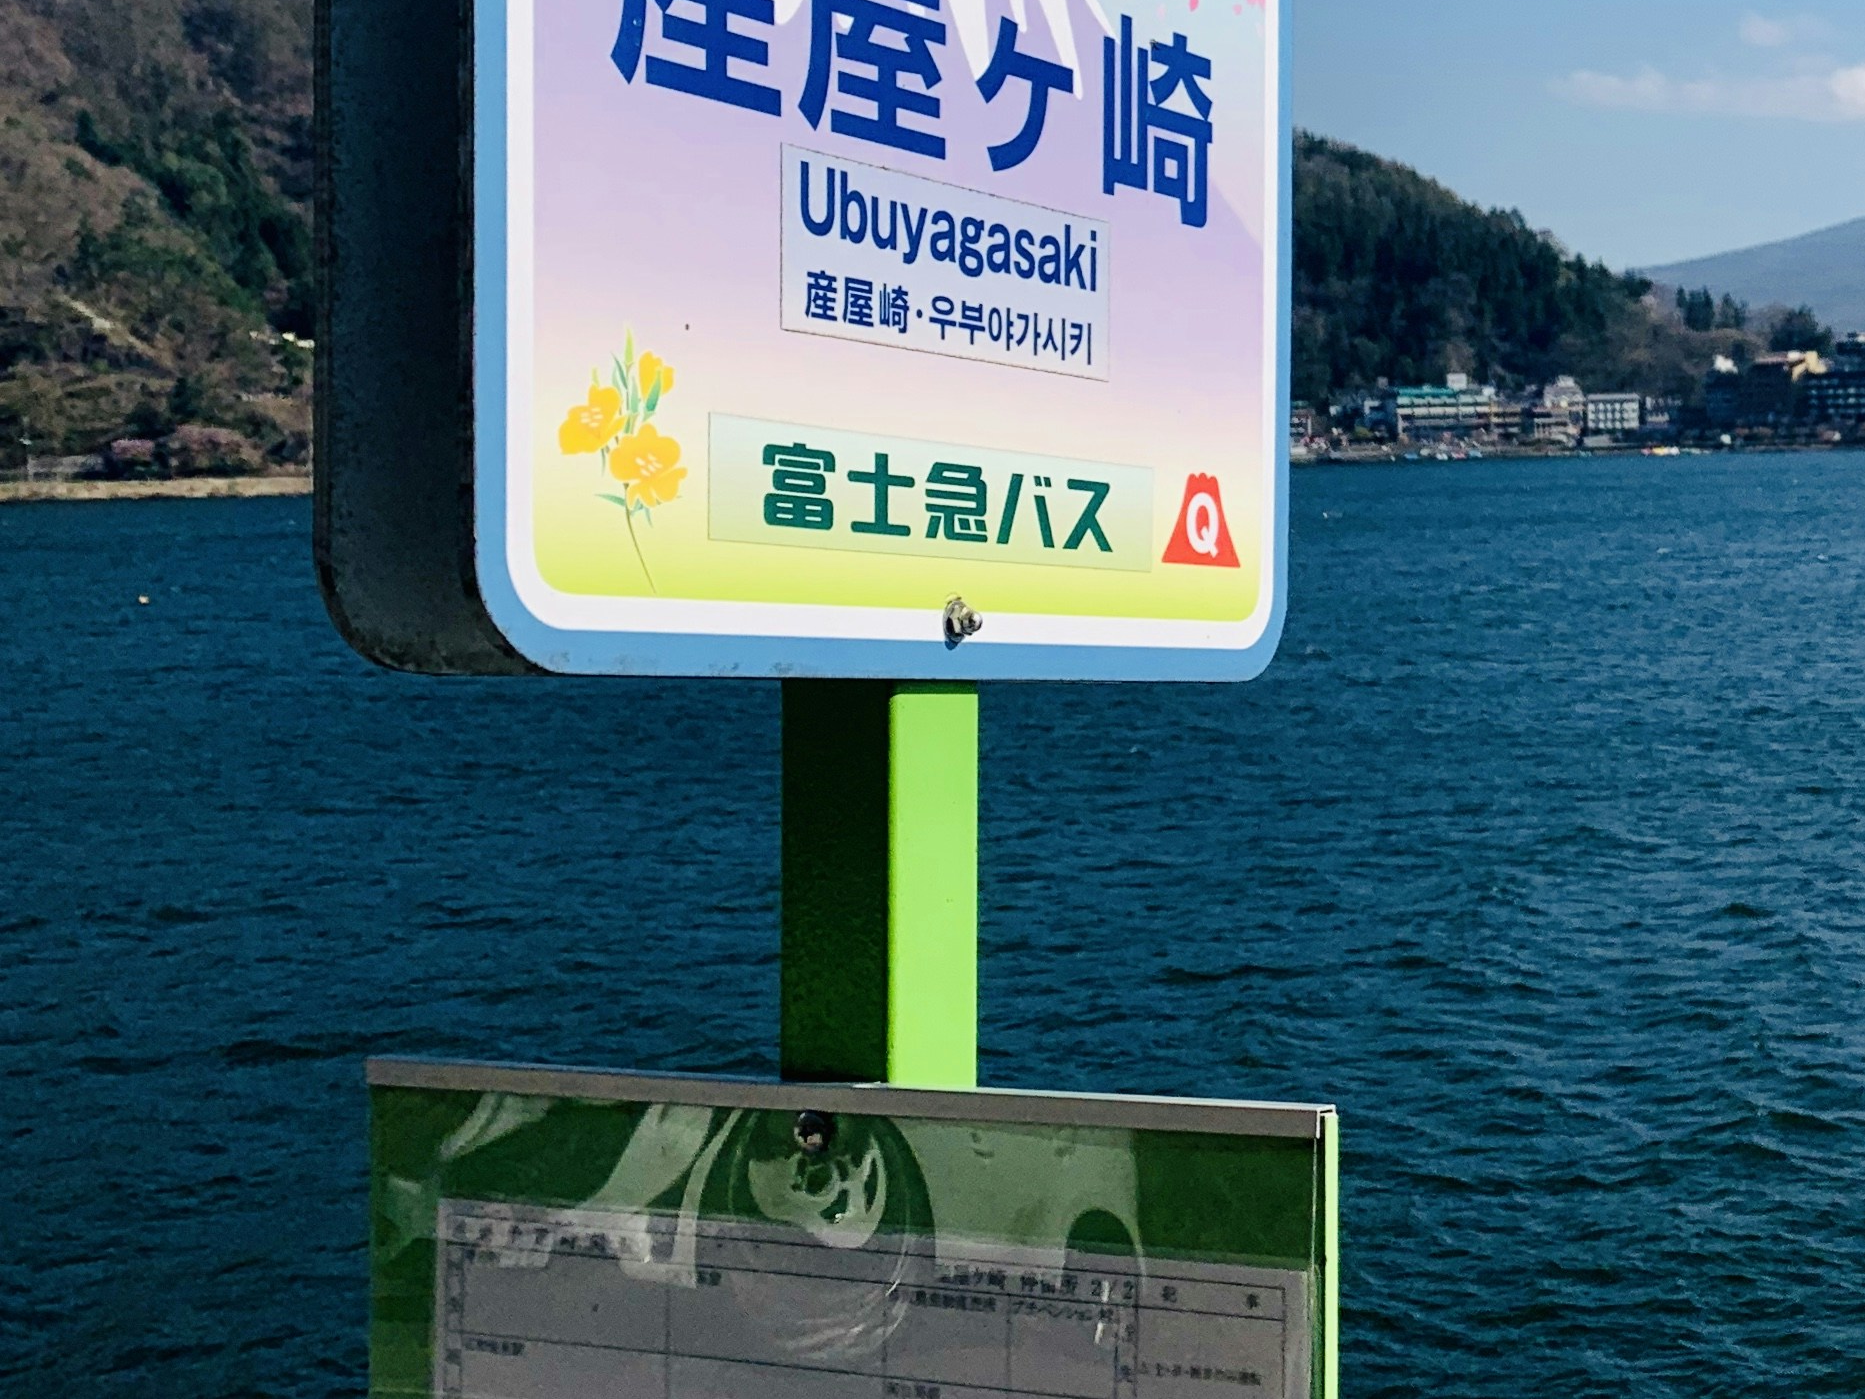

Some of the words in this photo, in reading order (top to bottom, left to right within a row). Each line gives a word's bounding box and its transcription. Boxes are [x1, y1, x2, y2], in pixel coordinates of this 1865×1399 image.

[799, 160, 1098, 293] Ubuyagasaki
[761, 441, 1115, 554] 富士急バス
[1185, 491, 1219, 558] Q
